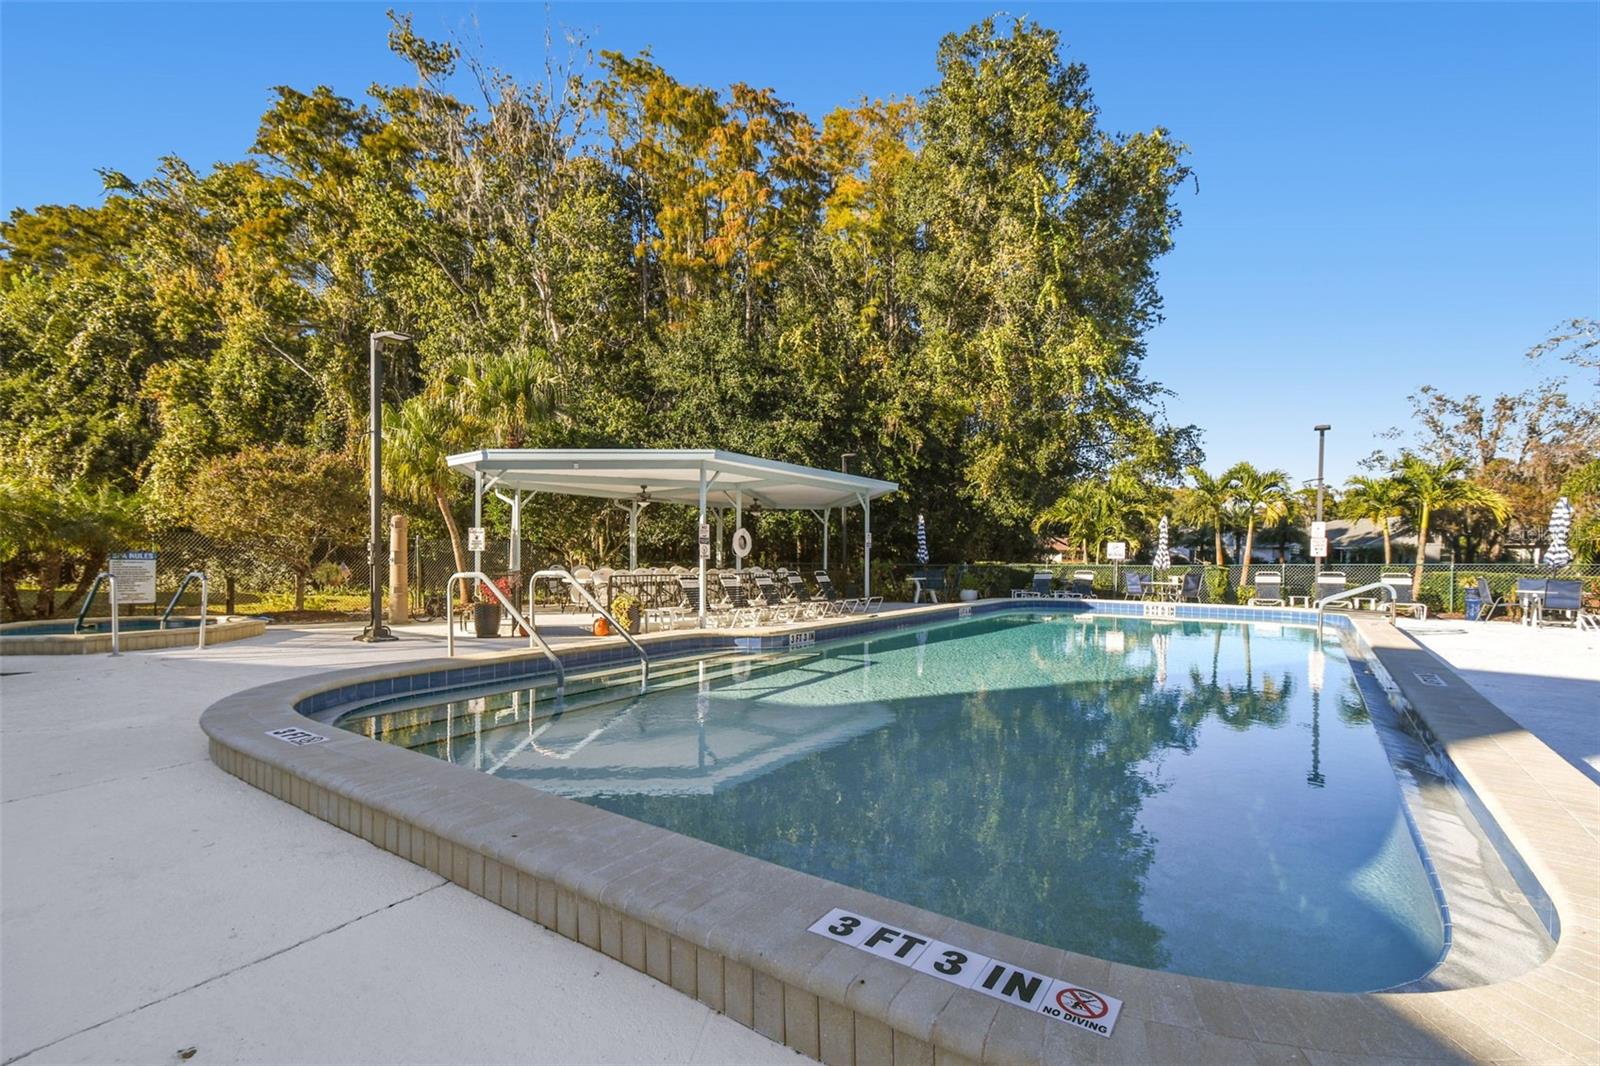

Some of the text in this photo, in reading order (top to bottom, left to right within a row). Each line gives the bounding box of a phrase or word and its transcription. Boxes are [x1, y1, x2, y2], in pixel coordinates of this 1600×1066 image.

[791, 635, 795, 644] 3
[796, 633, 802, 643] FT
[828, 916, 1043, 1003] 3 FT 3 IN
[1042, 1005, 1108, 1034] NO DIVING
